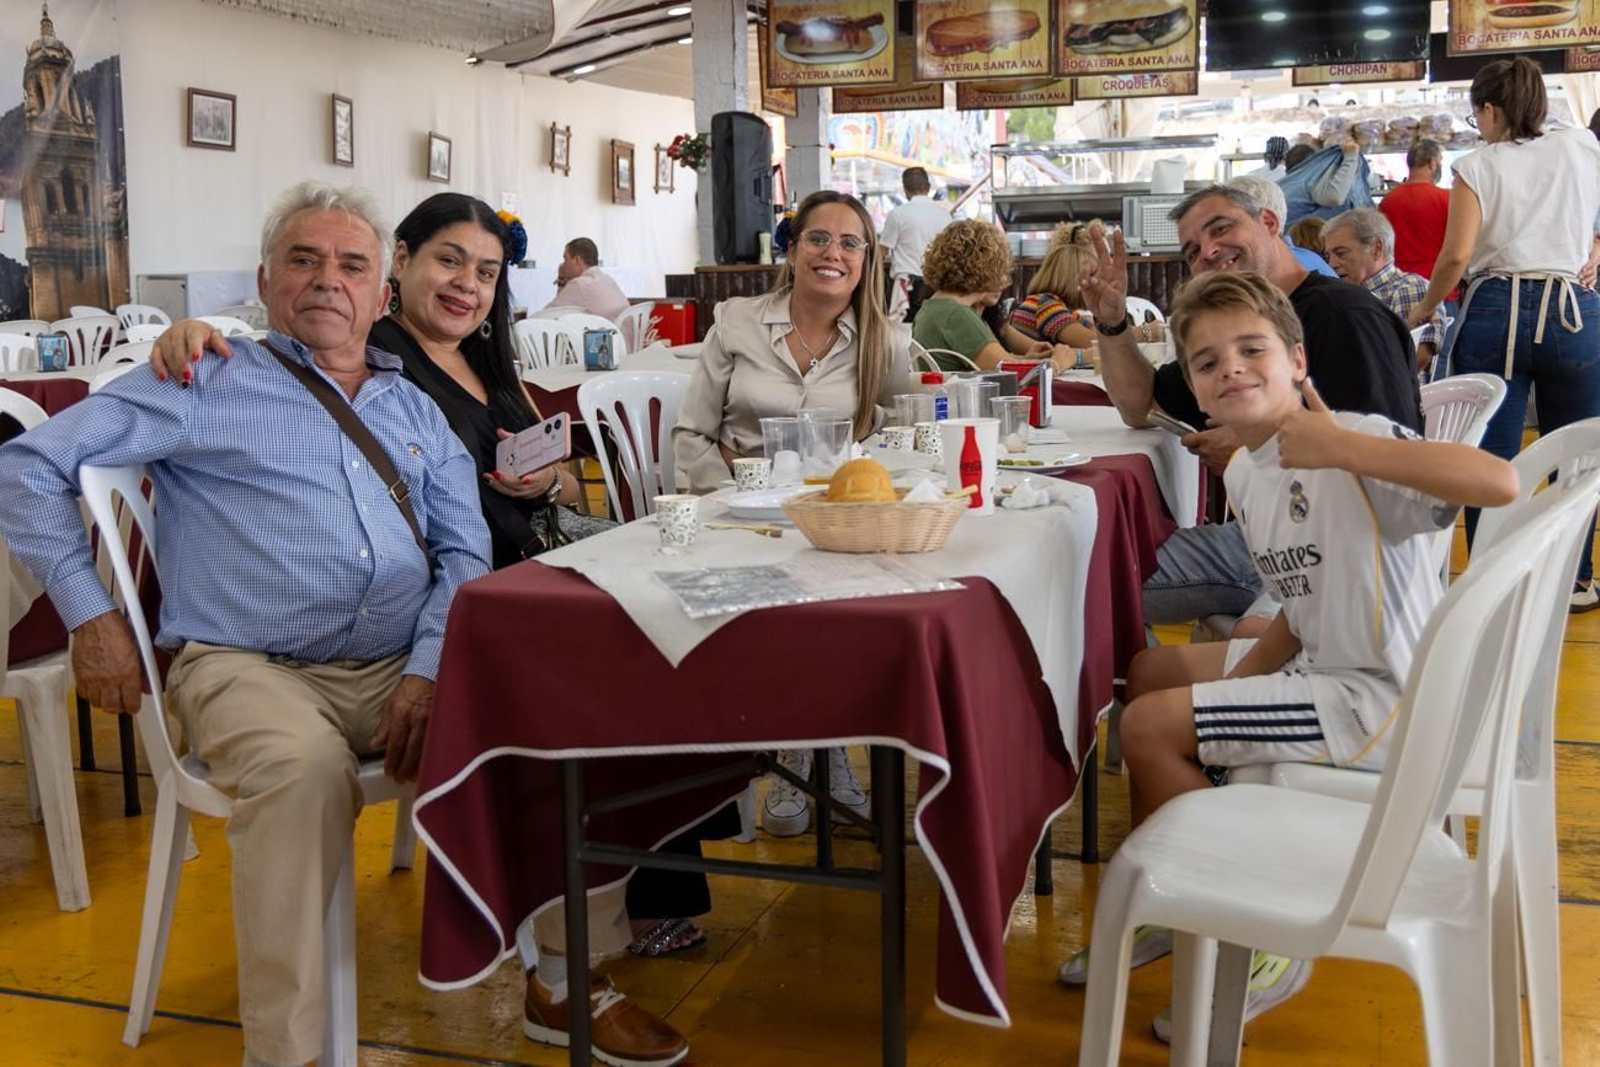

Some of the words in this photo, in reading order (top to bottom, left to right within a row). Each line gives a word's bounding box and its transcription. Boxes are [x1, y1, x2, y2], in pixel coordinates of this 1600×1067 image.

[1458, 32, 1530, 45] BOCATERIA
[1533, 28, 1577, 40] SANTA
[983, 59, 1019, 71] SANTA
[1020, 58, 1043, 69] ANA
[1062, 58, 1126, 70] BOCATERIA
[1128, 56, 1164, 67] SANTA
[1166, 54, 1191, 65] ANA
[832, 69, 866, 80] SANTA
[868, 68, 889, 78] ANA
[1328, 63, 1388, 77] CHORIPAN
[1102, 78, 1169, 91] CROQUETAS
